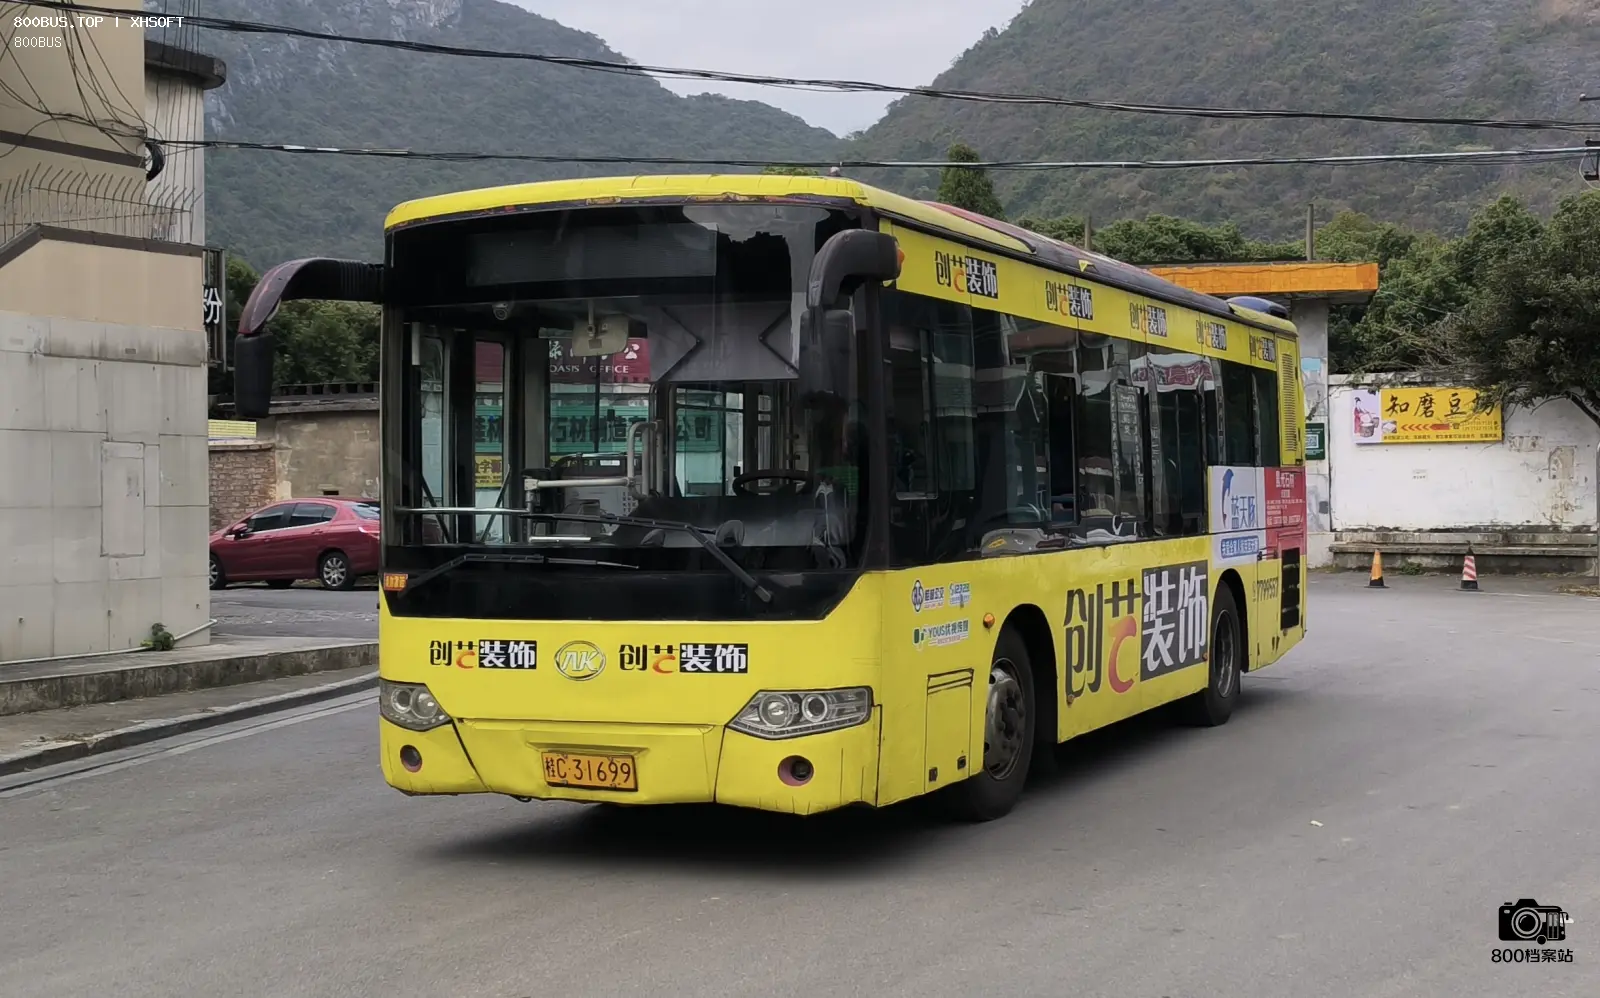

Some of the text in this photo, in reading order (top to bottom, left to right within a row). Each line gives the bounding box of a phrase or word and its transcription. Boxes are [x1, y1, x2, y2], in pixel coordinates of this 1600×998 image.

[934, 250, 999, 299] 创艺装饰
[1045, 280, 1094, 321] 创艺装饰
[1064, 561, 1208, 699] 创艺装饰
[429, 640, 537, 669] 创艺装饰
[618, 643, 748, 674] 创艺装饰
